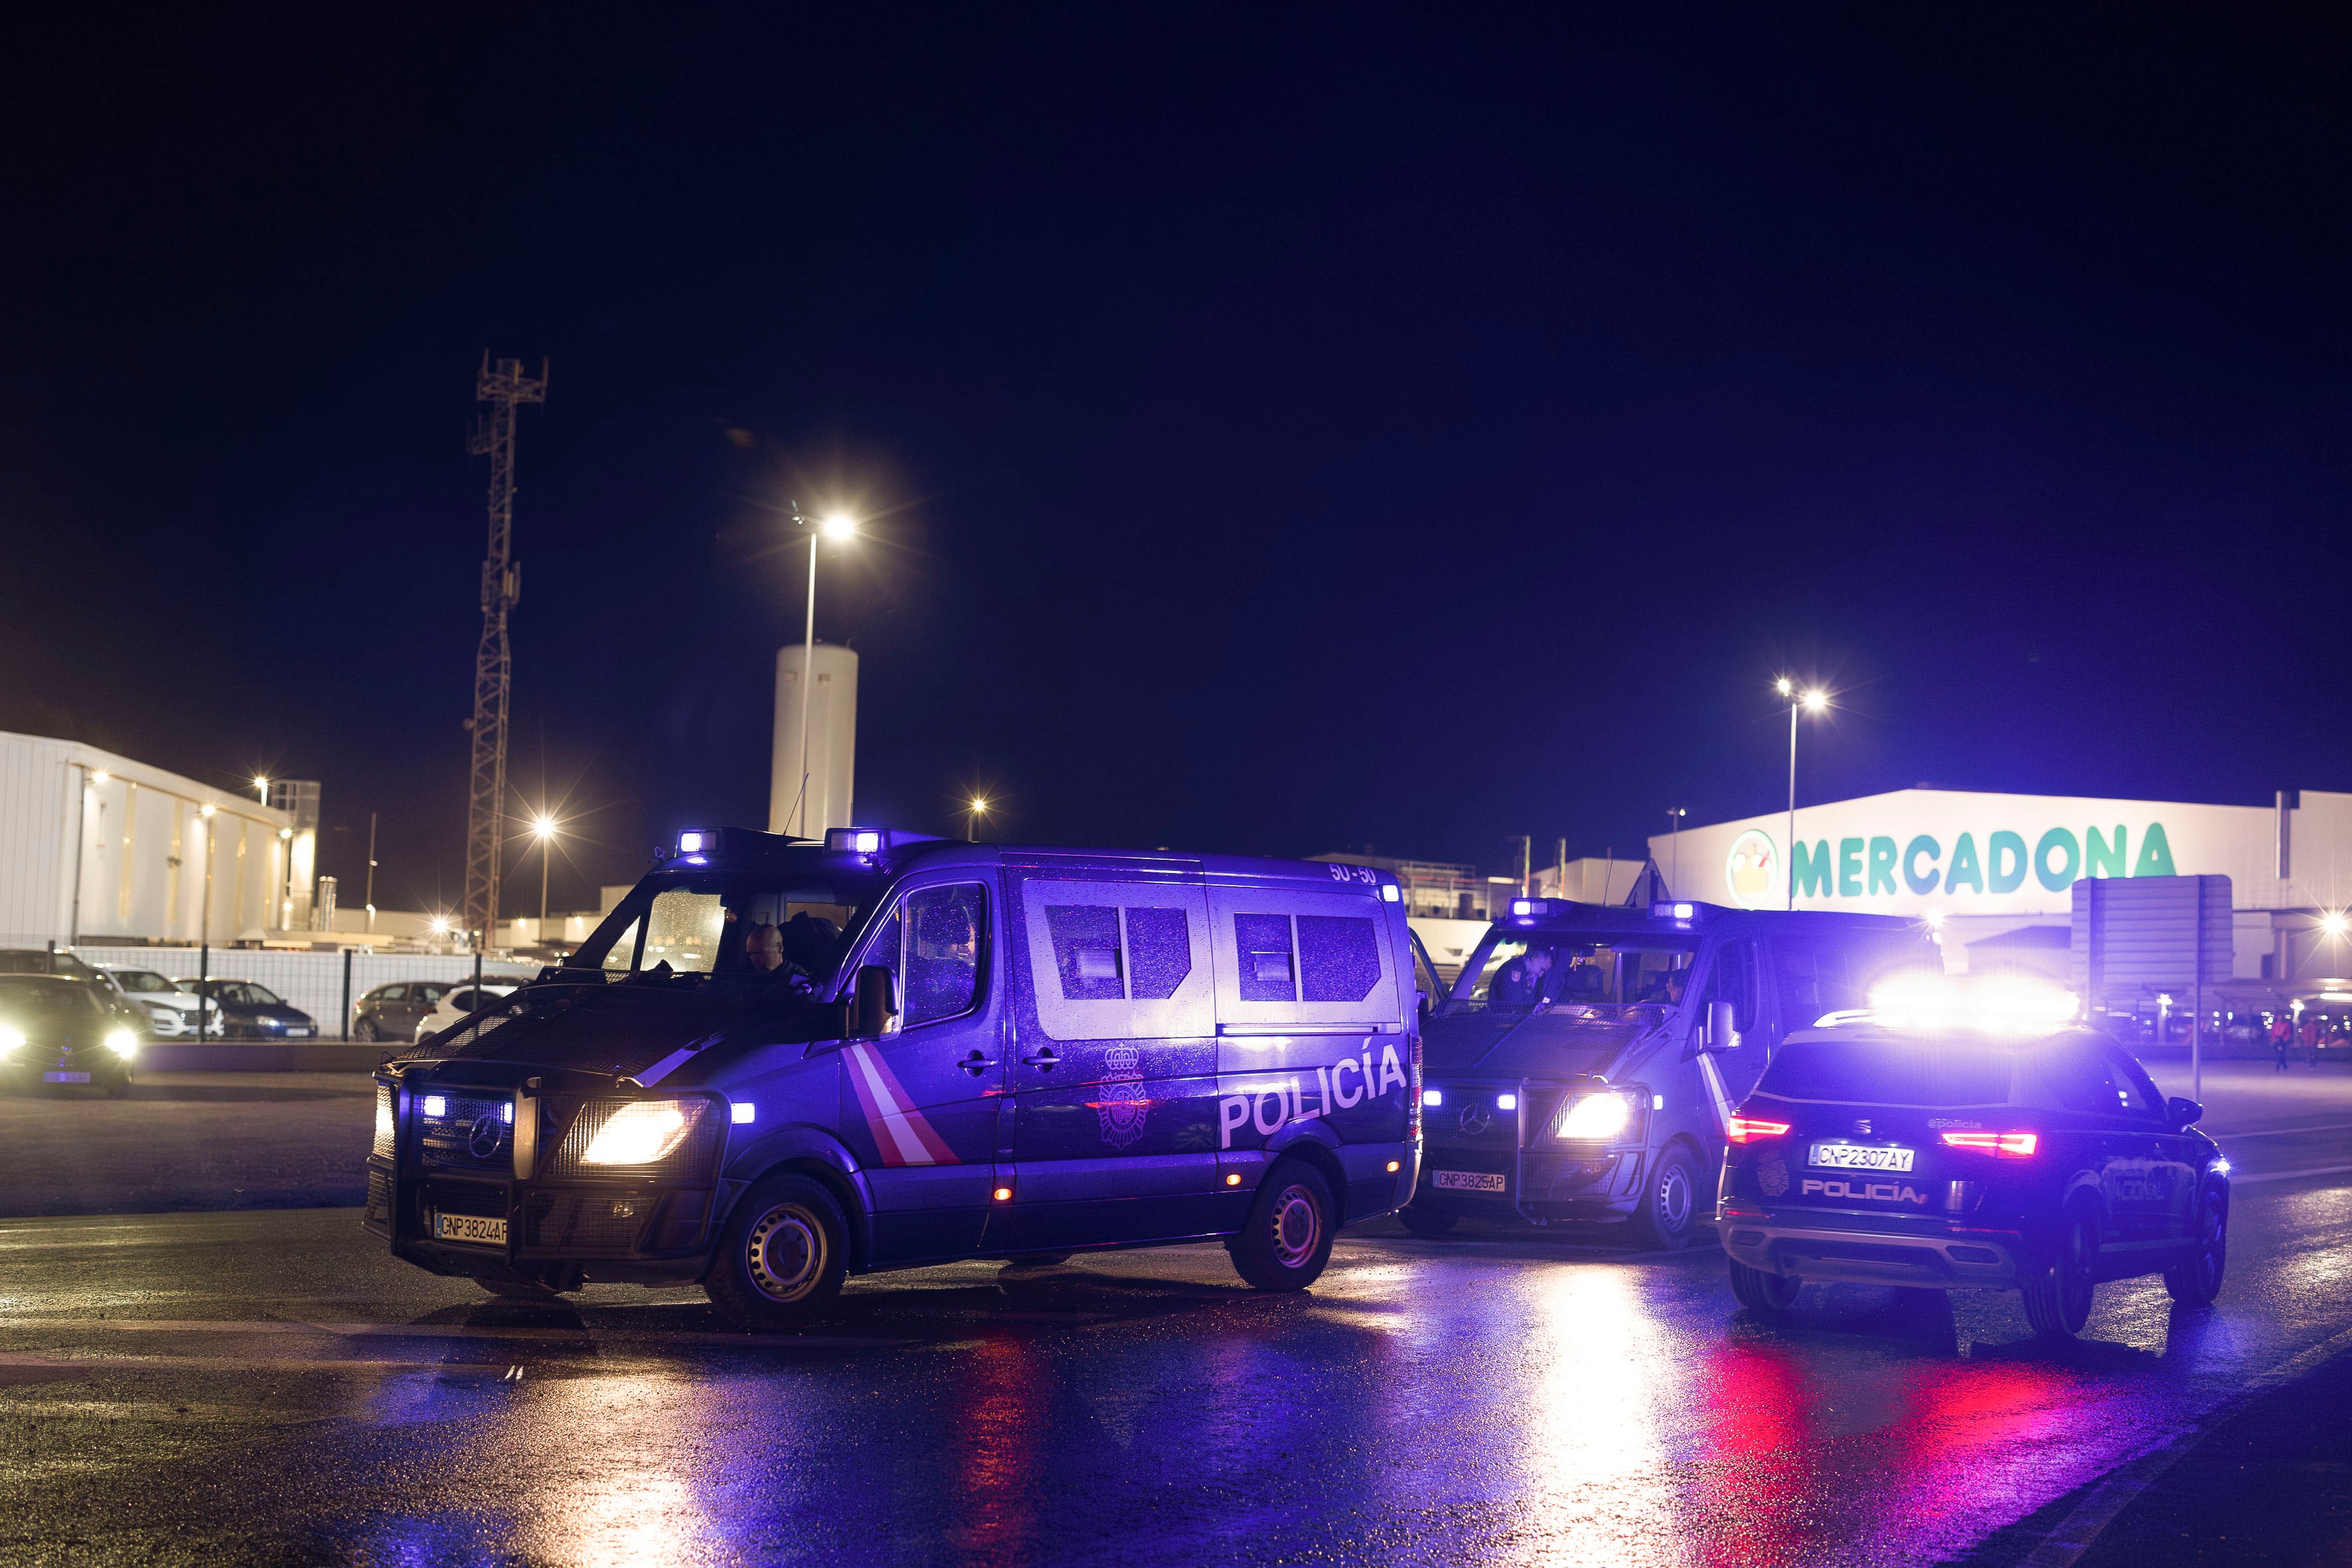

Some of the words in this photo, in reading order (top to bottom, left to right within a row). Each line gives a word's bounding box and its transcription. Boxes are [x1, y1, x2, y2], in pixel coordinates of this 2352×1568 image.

[1791, 822, 2176, 898] MERCADONA
[1220, 1037, 1407, 1149] POLICÍA
[1820, 1148, 1910, 1168] CNP2307AY
[1439, 1173, 1504, 1189] CNP3825AP
[1802, 1180, 1919, 1204] POLICÍA
